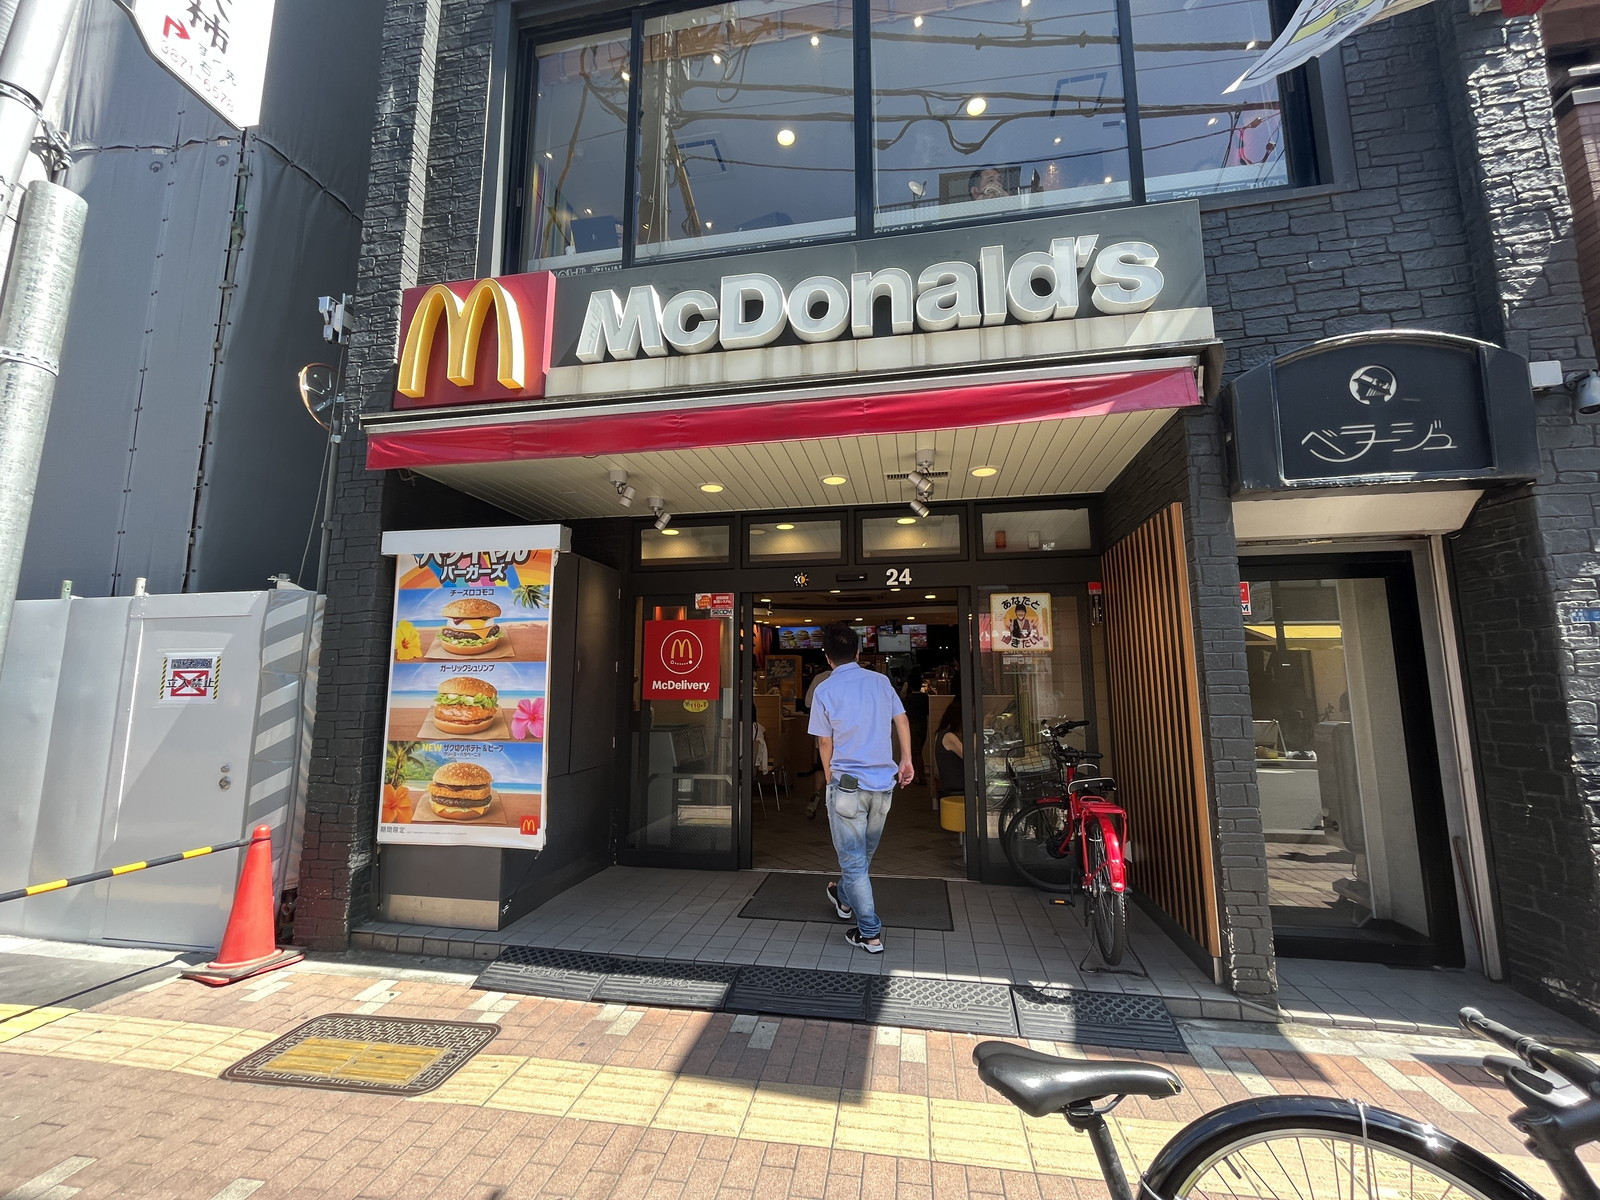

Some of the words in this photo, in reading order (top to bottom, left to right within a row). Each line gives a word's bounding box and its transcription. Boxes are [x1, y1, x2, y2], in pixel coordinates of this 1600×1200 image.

[575, 233, 1166, 363] McDonald's
[1301, 420, 1458, 463] ベラージュ
[440, 563, 505, 582] バーガーズ
[885, 568, 912, 586] 24
[449, 589, 495, 597] チーズロコモコ
[1001, 596, 1041, 611] あなたと
[440, 664, 496, 673] ガーリックシュリンプ
[165, 677, 215, 688] 立入禁止
[652, 679, 710, 693] McDelivery
[422, 743, 443, 753] NEW
[380, 826, 406, 834] 期間限定
[913, 1000, 951, 1009] SAFETY
